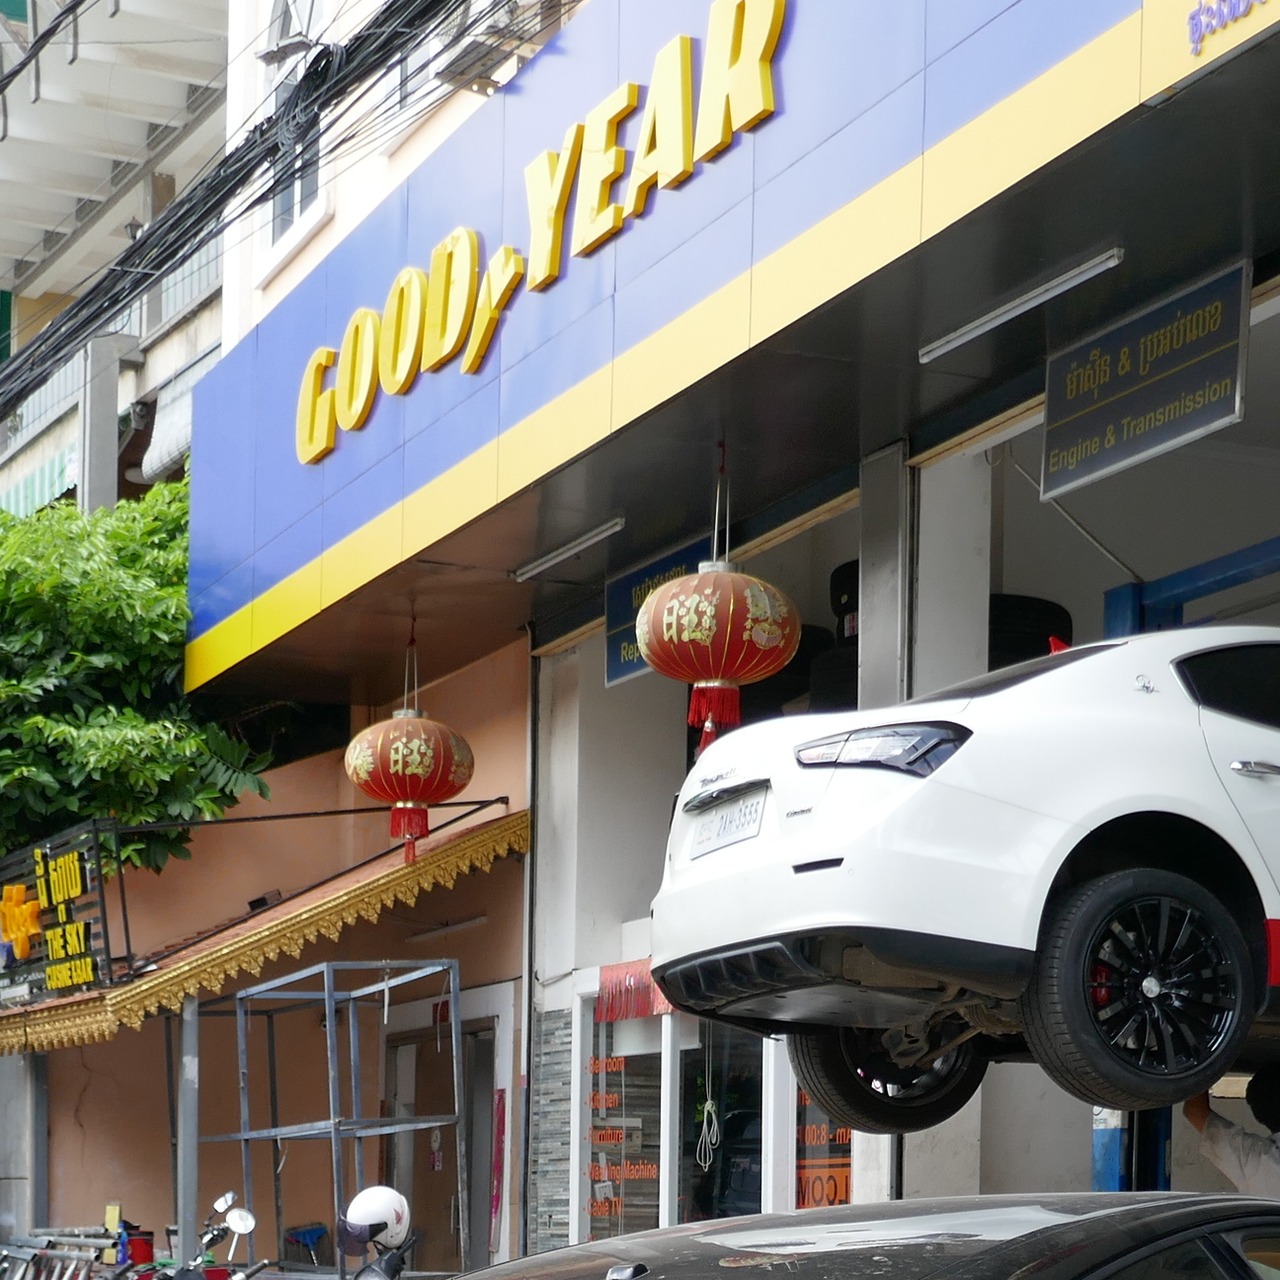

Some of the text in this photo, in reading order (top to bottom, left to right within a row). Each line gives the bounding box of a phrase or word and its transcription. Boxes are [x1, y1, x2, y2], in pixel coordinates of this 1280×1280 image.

[1118, 347, 1131, 376] &
[1048, 378, 1232, 473] Engine & Transmission
[621, 641, 640, 663] Rep
[46, 928, 66, 960] THE
[65, 921, 85, 956] SKY
[623, 1159, 657, 1180] Machine
